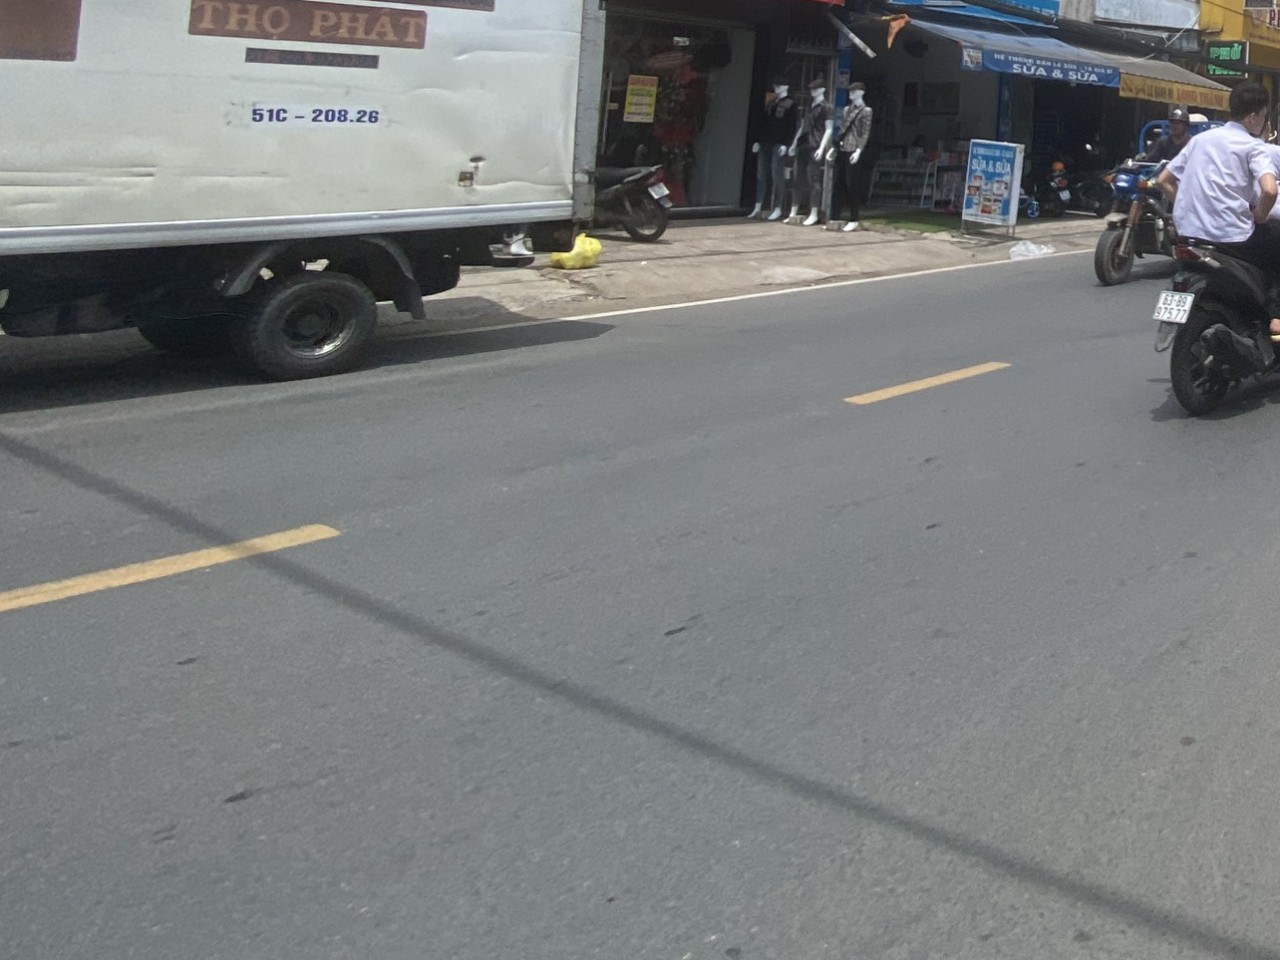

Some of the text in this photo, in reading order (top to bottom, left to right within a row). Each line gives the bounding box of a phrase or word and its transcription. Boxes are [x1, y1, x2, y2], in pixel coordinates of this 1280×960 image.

[193, 1, 290, 39] THỌ
[1052, 69, 1063, 79] &
[252, 108, 380, 124] 51C 208.26
